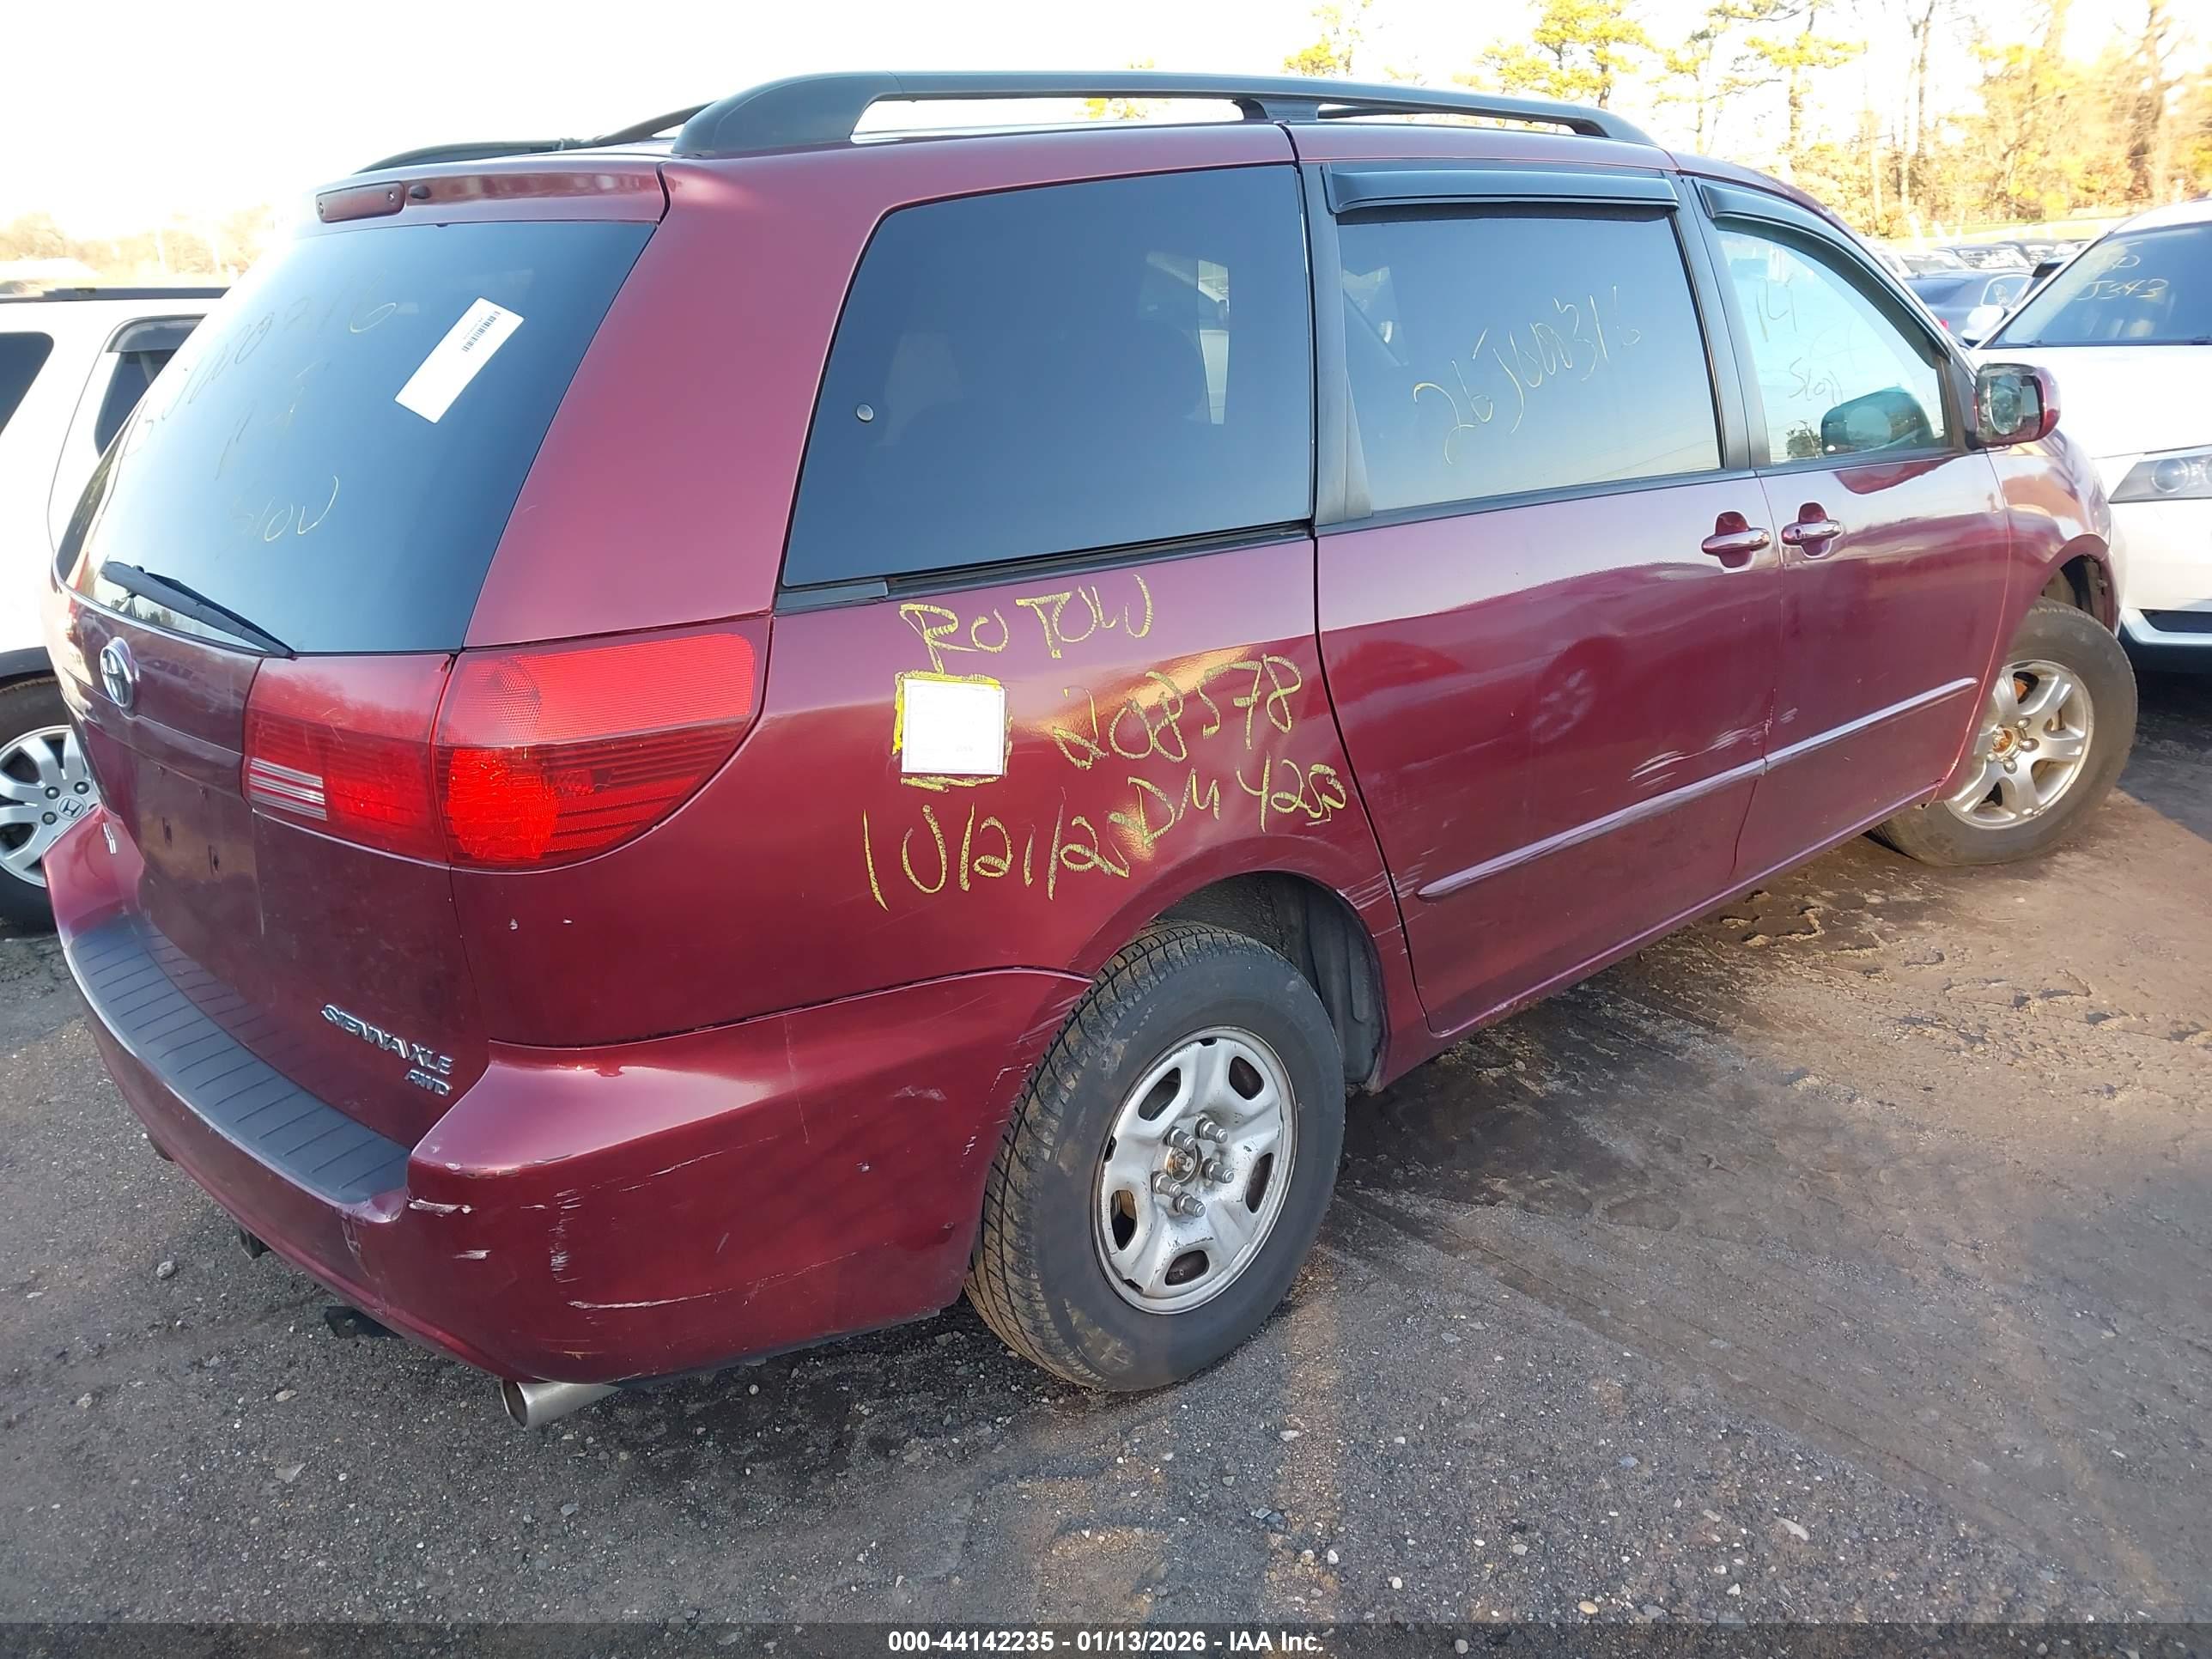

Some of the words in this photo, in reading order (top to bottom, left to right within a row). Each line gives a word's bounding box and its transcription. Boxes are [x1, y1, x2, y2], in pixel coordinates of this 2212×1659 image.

[320, 1003, 410, 1060] SIENNA
[409, 1042, 456, 1076] XLE
[404, 1068, 453, 1097] AWD
